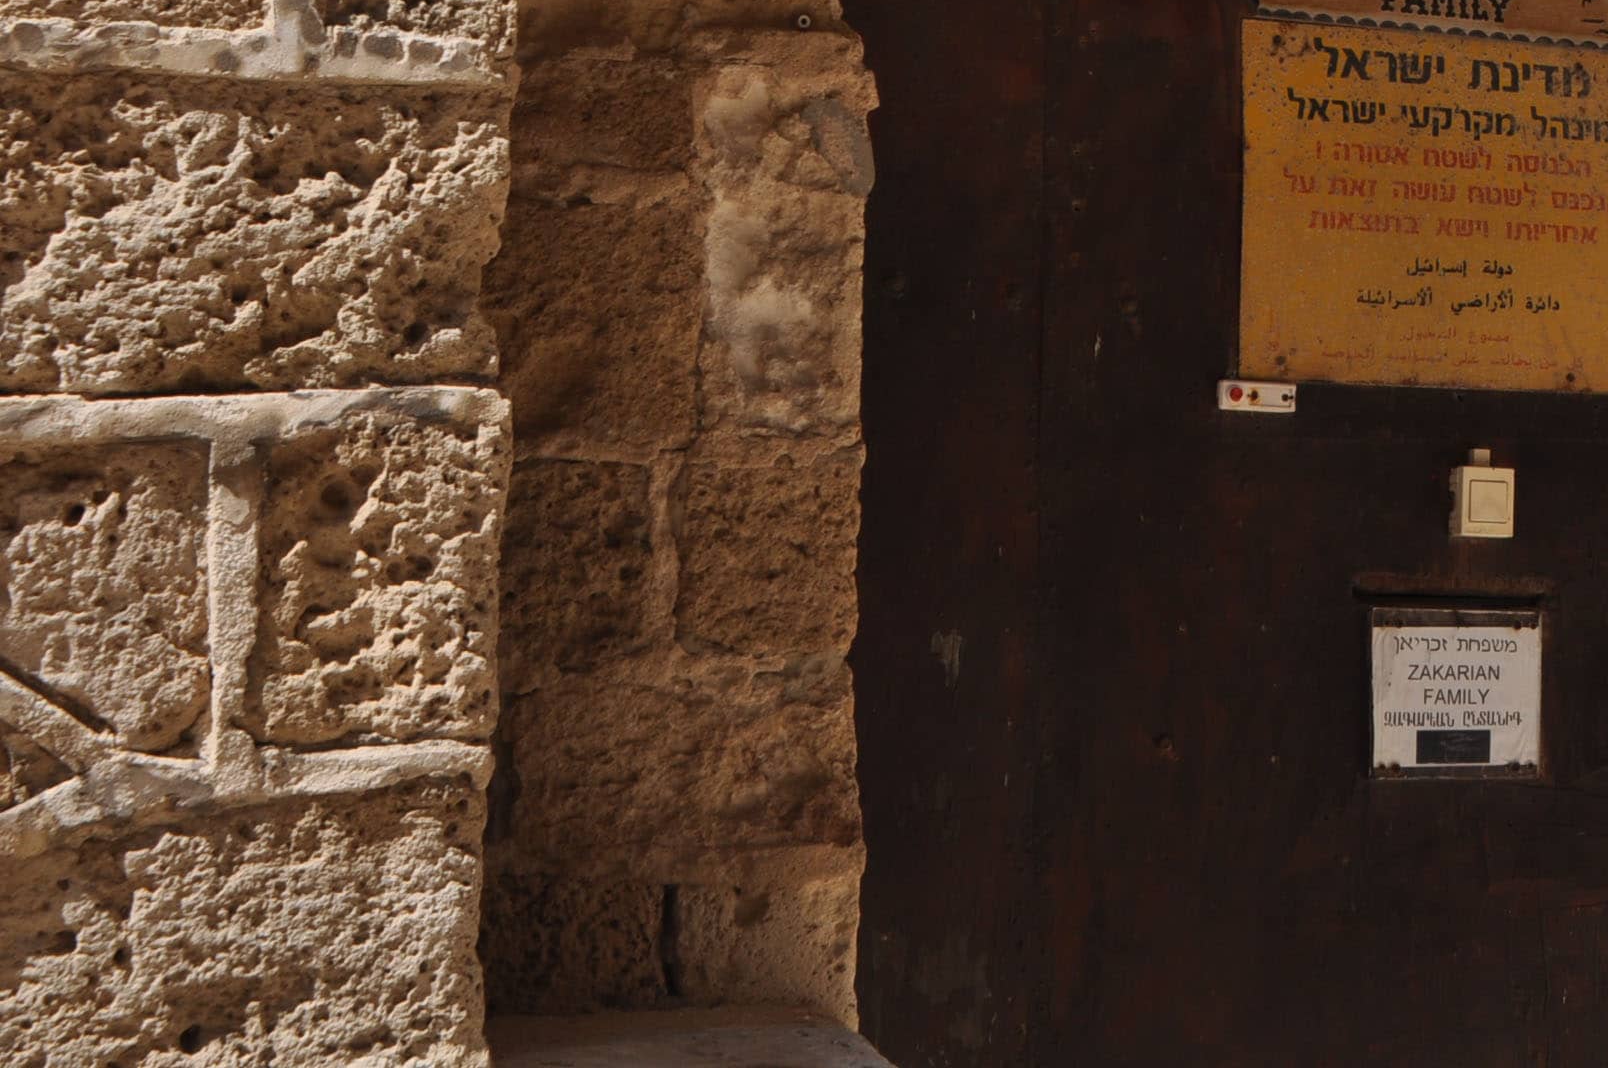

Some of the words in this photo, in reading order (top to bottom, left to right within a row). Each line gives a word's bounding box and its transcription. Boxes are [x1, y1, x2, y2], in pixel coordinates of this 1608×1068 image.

[1314, 37, 1445, 84] ישראל
[1469, 58, 1592, 98] מדינת
[1288, 88, 1386, 124] ישראל
[1400, 105, 1516, 140] מקרקעי
[1333, 142, 1409, 165] אסורה
[1424, 146, 1492, 170] לשטח
[1283, 166, 1316, 194] על
[1328, 176, 1378, 198] זאת
[1392, 179, 1457, 203] עושה
[1468, 181, 1537, 208] לשטח
[1308, 210, 1420, 234] בתוצאות
[1436, 216, 1489, 238] וישא
[1506, 219, 1598, 244] אחריותו
[1482, 259, 1513, 279] دولة
[1525, 294, 1560, 314] دائرة
[1394, 636, 1448, 654] זכריאן
[1457, 638, 1518, 653] משפחת
[1407, 664, 1500, 681] ZAKARIAN
[1423, 688, 1490, 705] FAMILY
